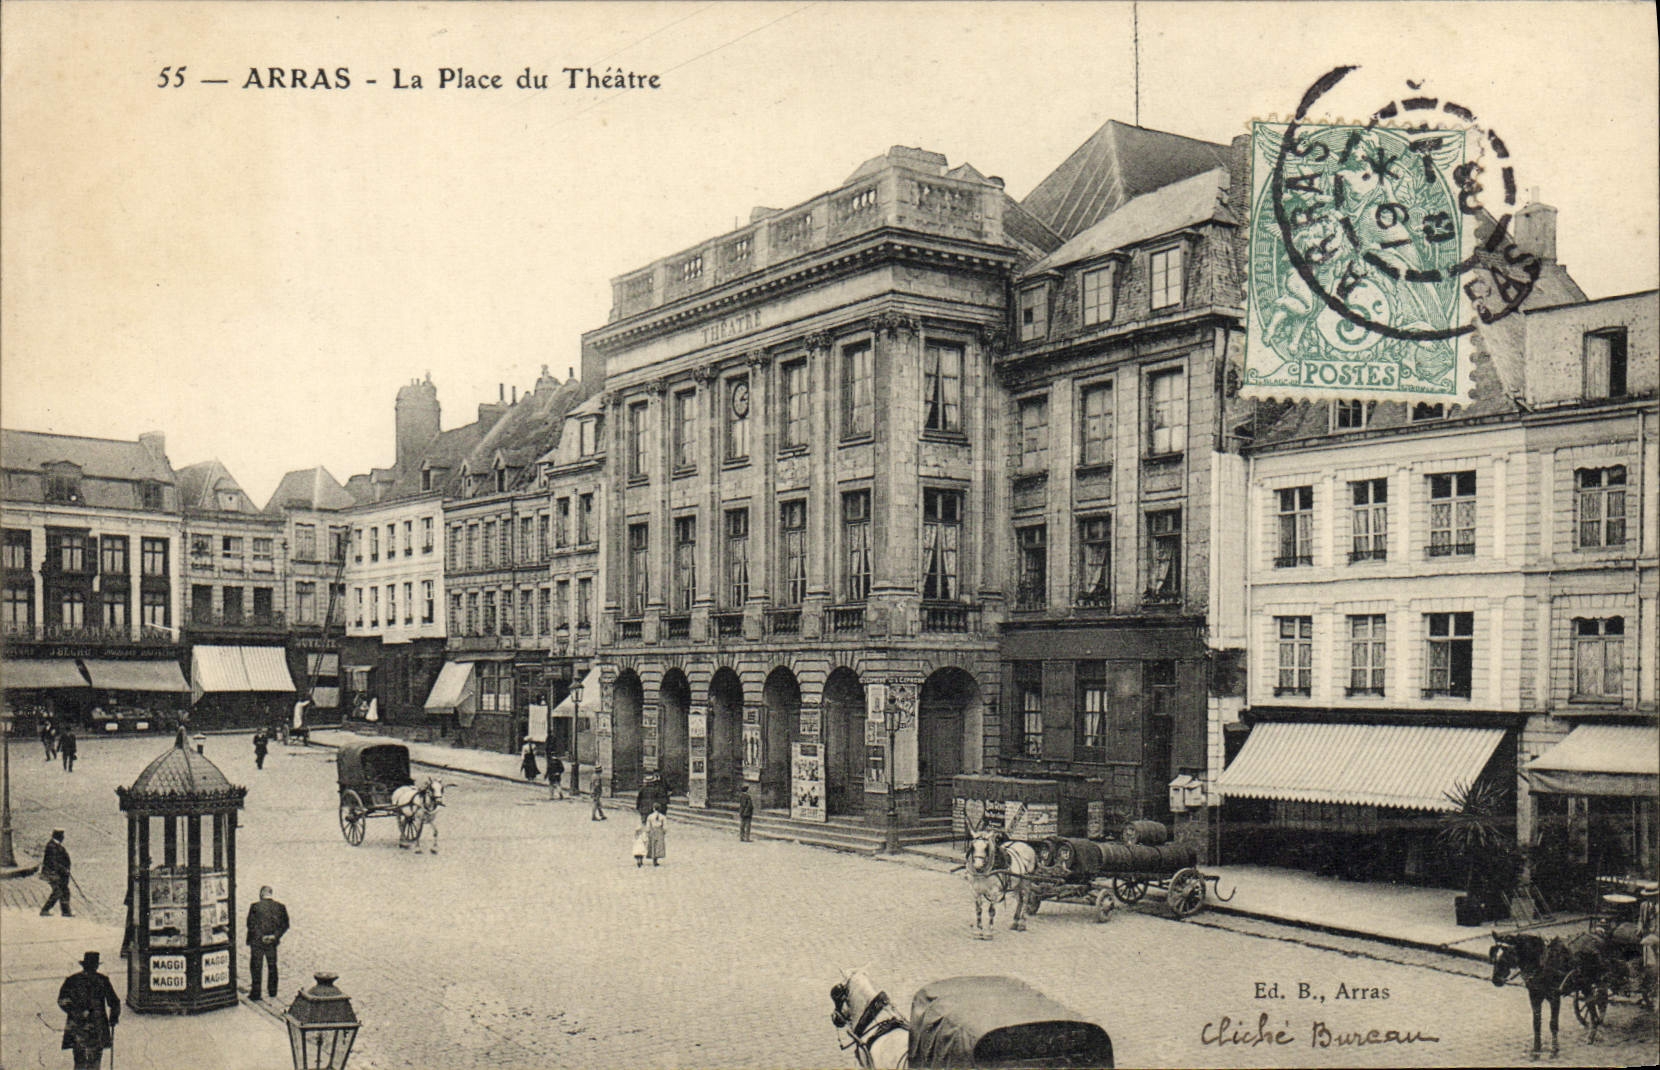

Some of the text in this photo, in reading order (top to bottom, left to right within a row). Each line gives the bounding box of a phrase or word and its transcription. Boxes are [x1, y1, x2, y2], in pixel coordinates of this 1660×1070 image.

[1285, 138, 1369, 299] ARRAS
[1302, 363, 1396, 387] POSTES
[152, 960, 184, 970] MAGGI
[204, 955, 228, 967] MAGGI
[152, 976, 184, 987] MAGGI
[204, 973, 228, 985] MAGGI
[1200, 1011, 1441, 1049] Cliché Bureau
